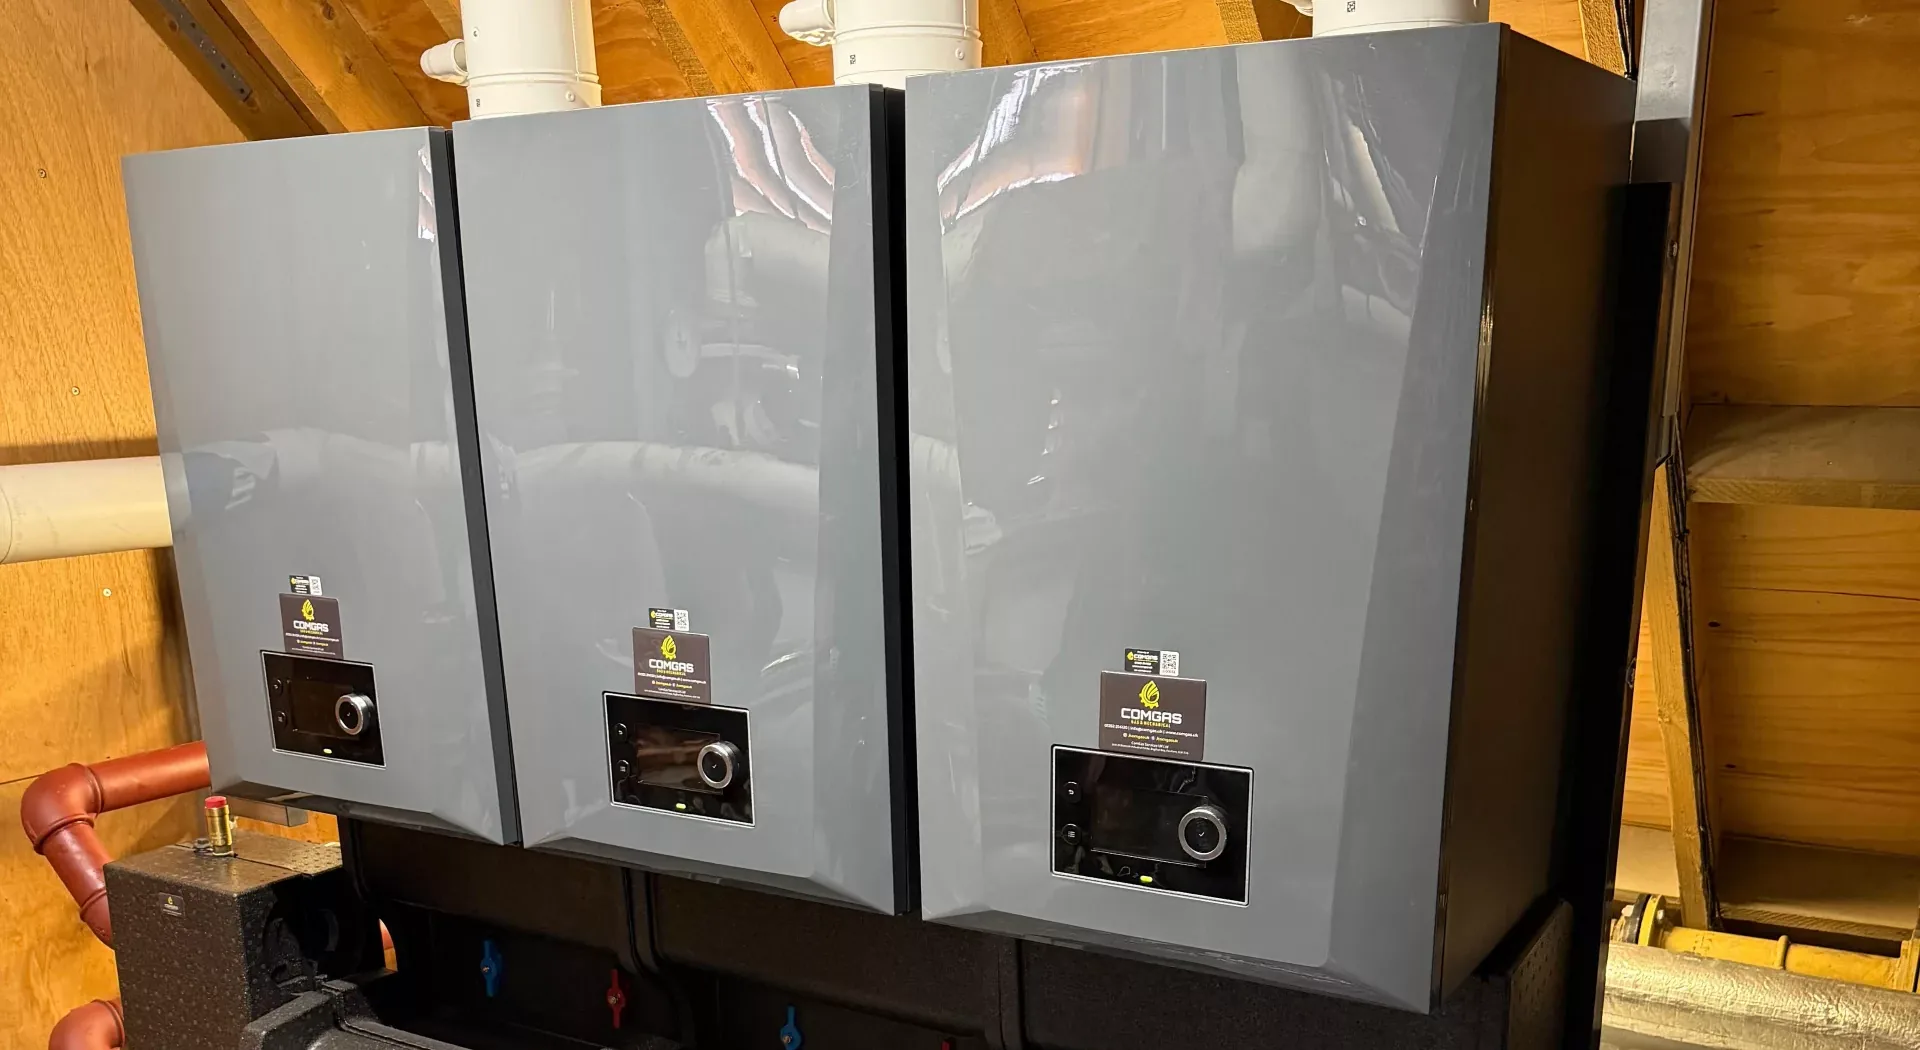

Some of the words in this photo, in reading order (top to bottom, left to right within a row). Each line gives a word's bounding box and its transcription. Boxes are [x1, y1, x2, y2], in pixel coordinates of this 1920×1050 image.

[293, 620, 329, 633] COMGAS
[648, 658, 694, 673] COMGAS
[1121, 708, 1182, 724] COMGAS
